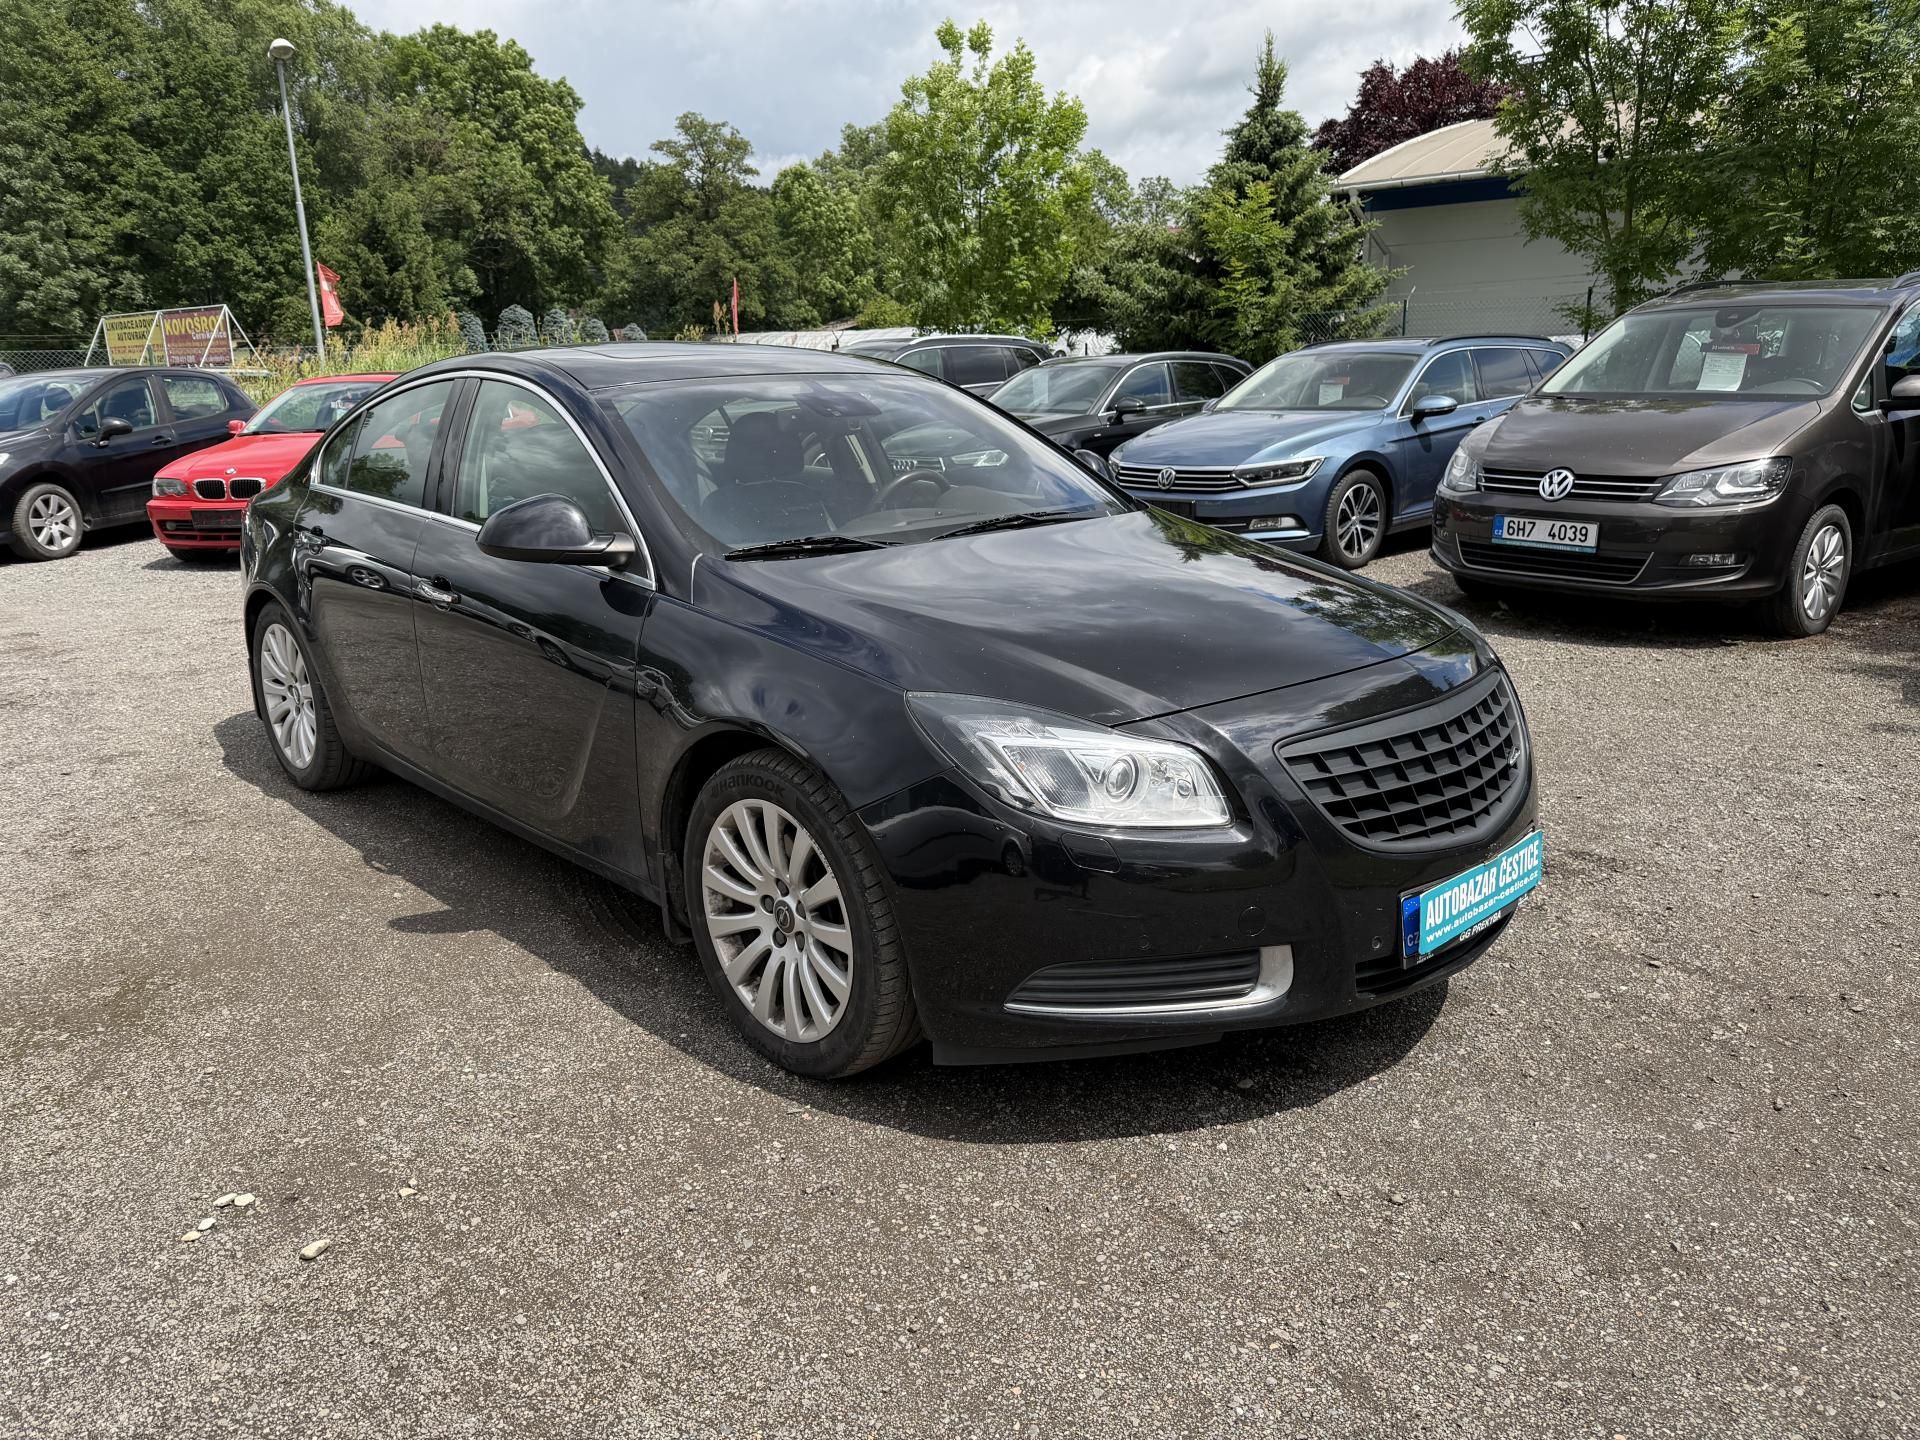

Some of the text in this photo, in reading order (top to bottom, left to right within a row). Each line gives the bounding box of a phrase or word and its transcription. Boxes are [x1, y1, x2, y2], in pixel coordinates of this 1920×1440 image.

[1506, 519, 1537, 538] 6H7
[1547, 523, 1589, 543] 4039
[1426, 839, 1540, 931] AUTOBAZAR ČESTICE
[1426, 869, 1539, 943] www.autobazar-cestice.cz
